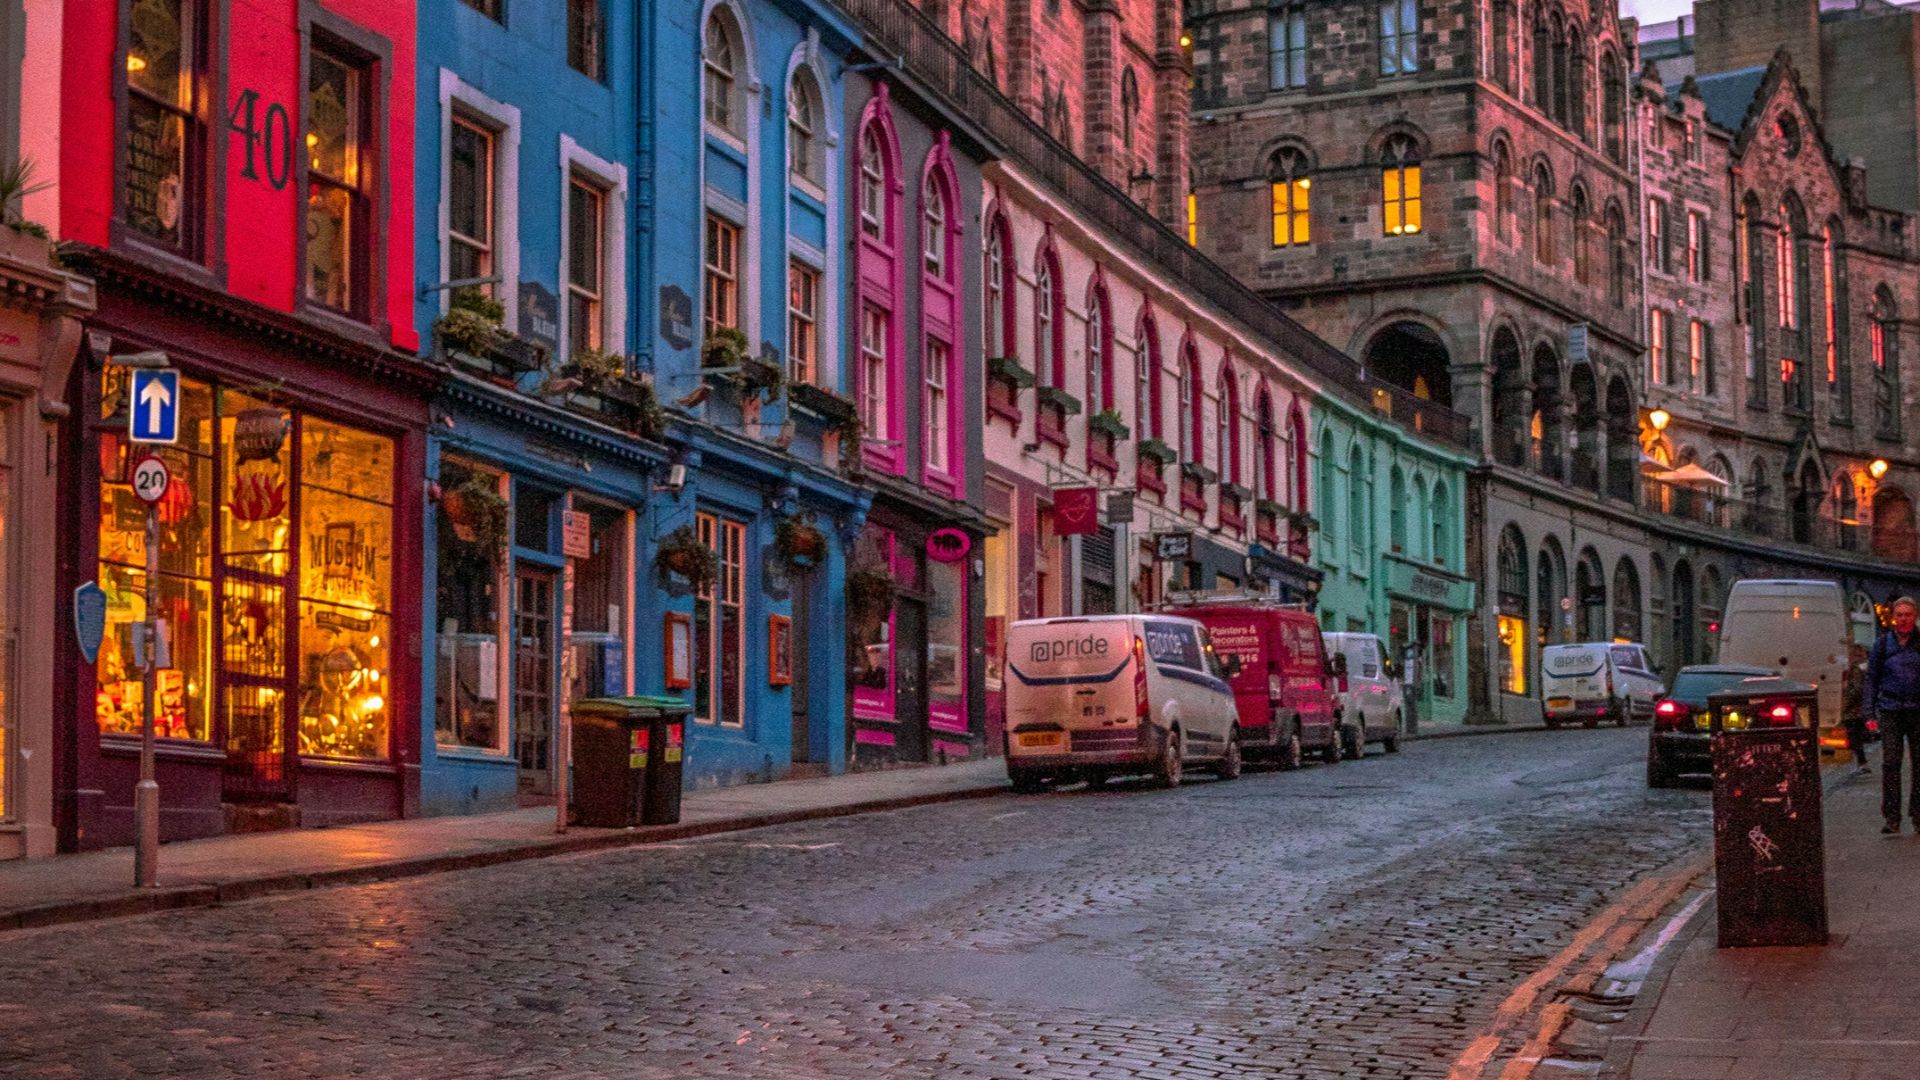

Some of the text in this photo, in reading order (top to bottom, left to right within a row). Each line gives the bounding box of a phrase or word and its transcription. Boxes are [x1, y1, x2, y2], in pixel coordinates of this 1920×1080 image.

[229, 88, 290, 190] 40
[138, 470, 165, 490] 20
[309, 532, 377, 580] MUSEUM
[1210, 625, 1256, 636] Painters &
[1052, 634, 1108, 661] pride
[1565, 654, 1593, 668] pride
